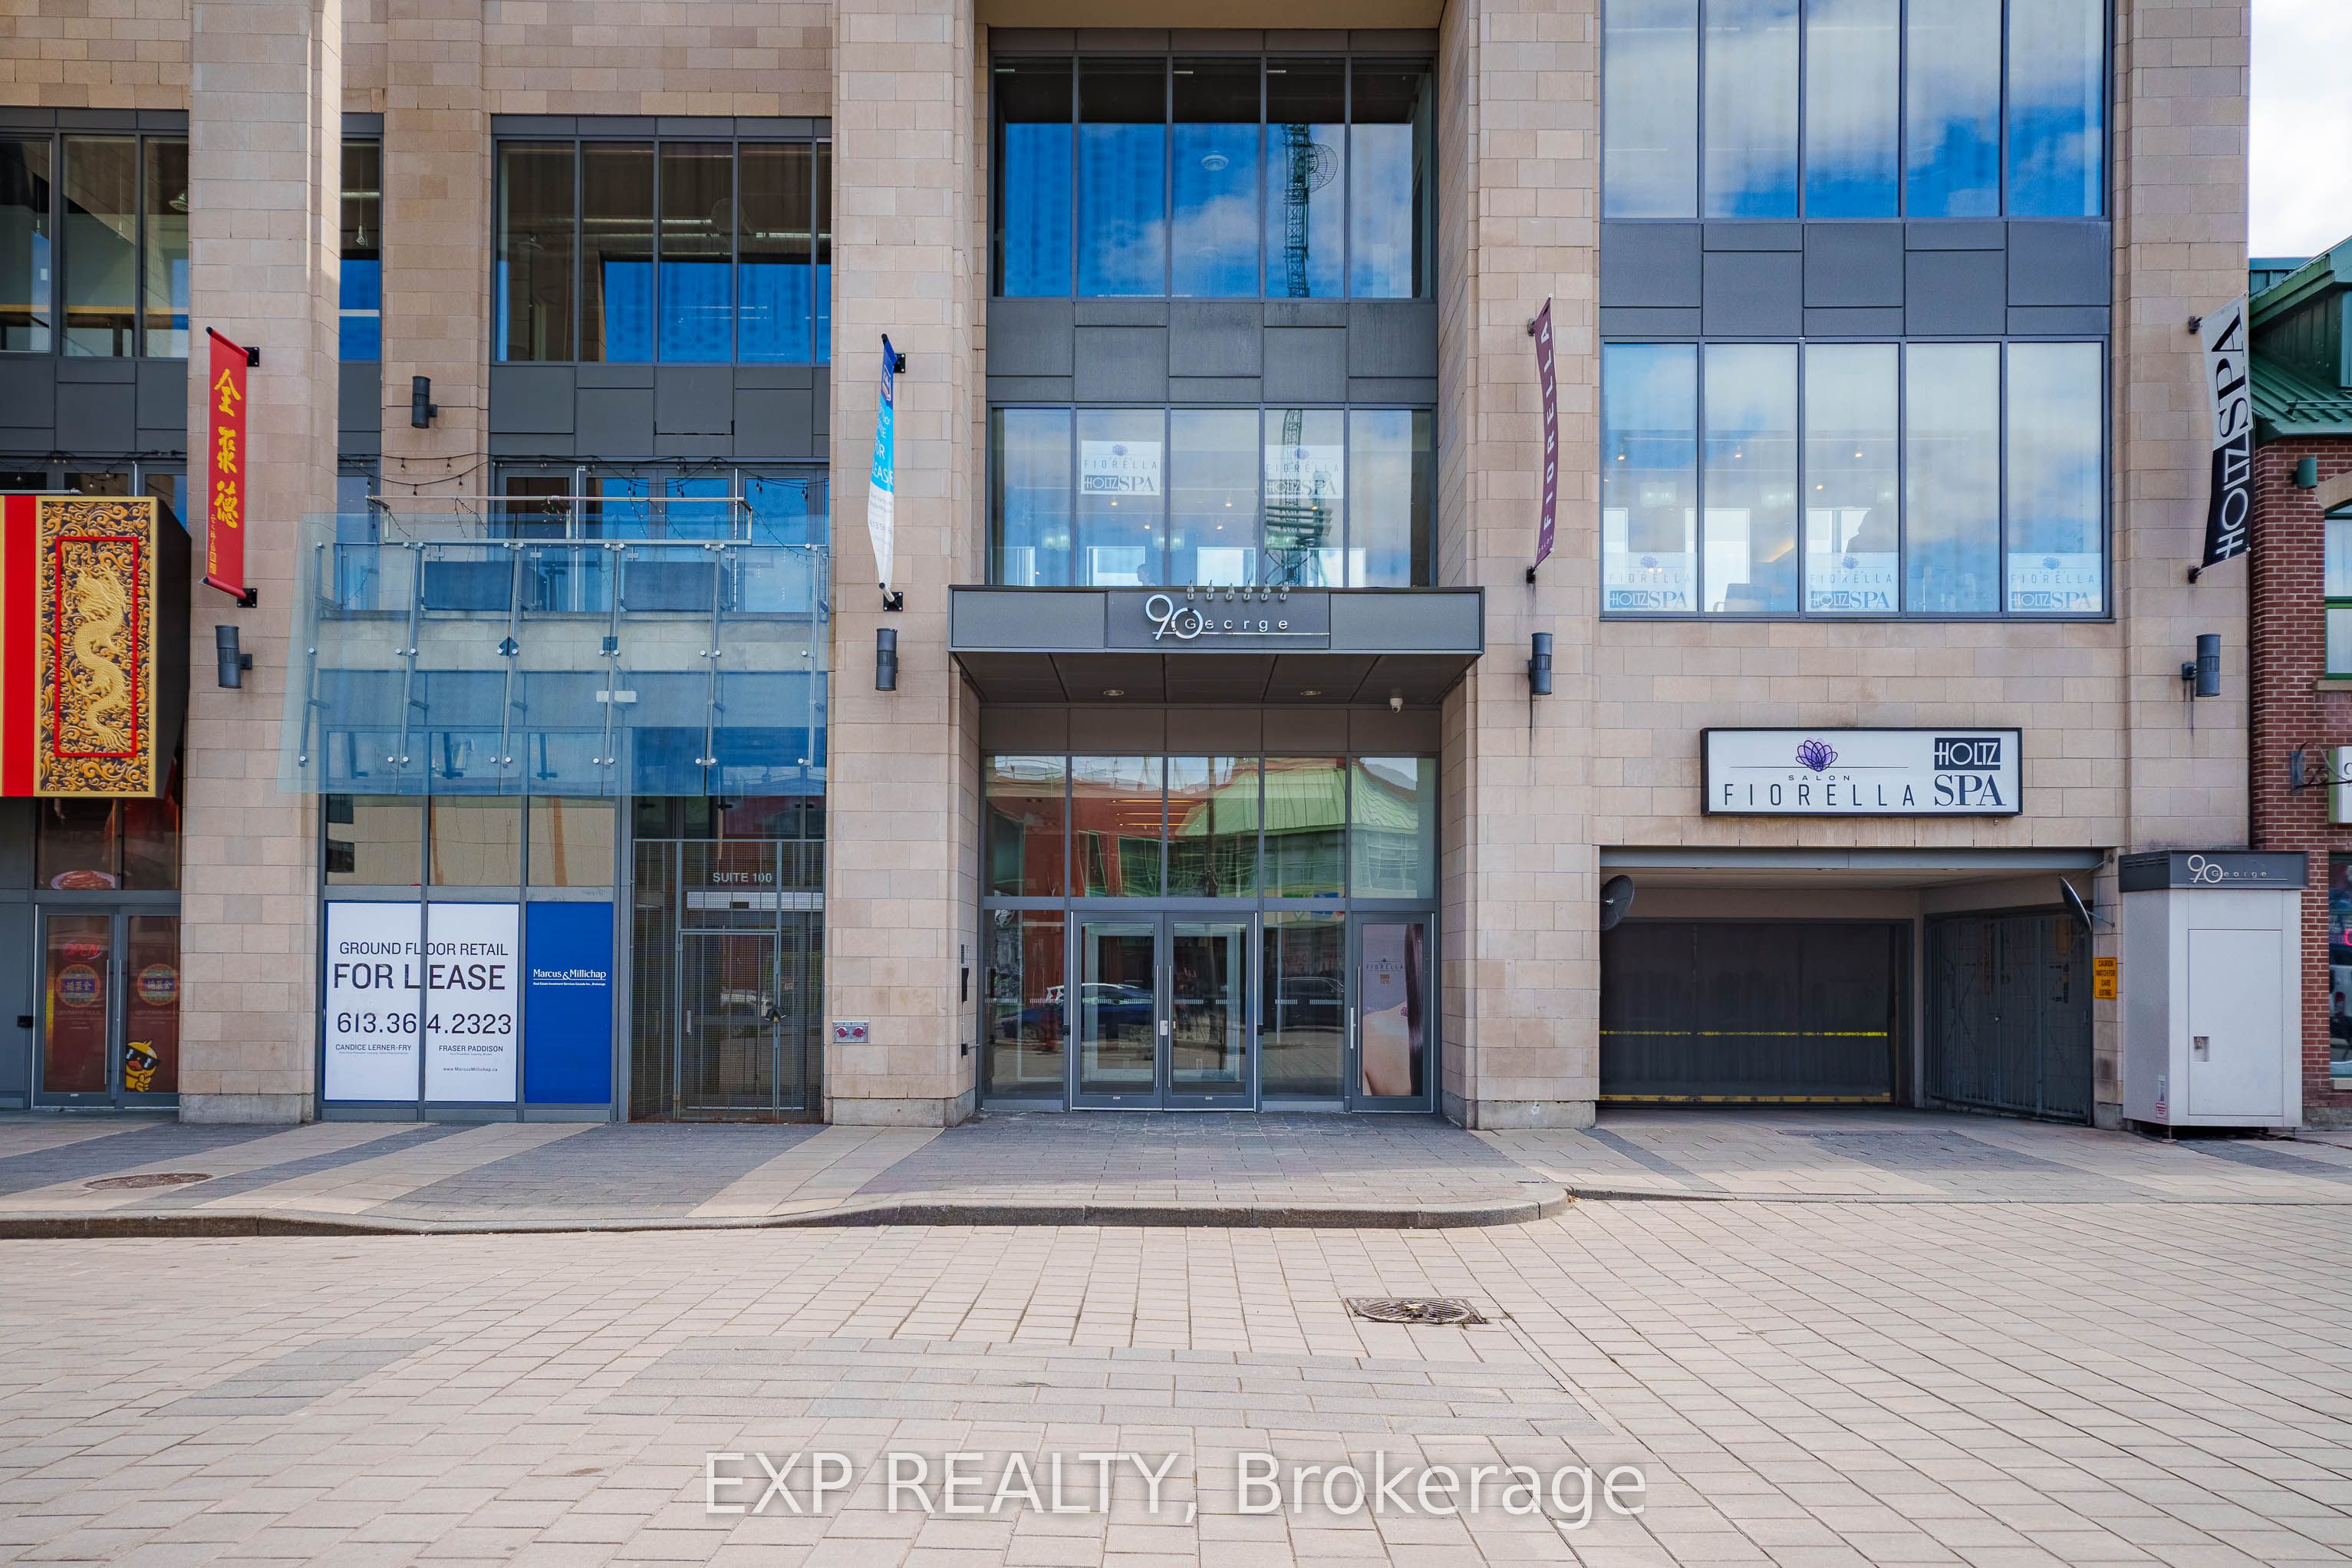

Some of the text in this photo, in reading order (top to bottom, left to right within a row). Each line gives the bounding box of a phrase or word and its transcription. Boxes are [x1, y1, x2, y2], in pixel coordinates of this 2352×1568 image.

[1540, 321, 1554, 532] FIORELLA
[2211, 306, 2251, 559] HOLTZ SPA
[213, 367, 242, 529] 全聚德
[1084, 460, 1157, 469] FIORELLA
[1266, 464, 1339, 473] FIORELLA
[1085, 476, 1155, 492] HOLTZ SPA
[1302, 479, 1336, 495] SPA
[1810, 574, 1892, 584] FIORELLA
[2011, 574, 2094, 584] FIORELLA
[1609, 590, 1688, 608] HOLTZ SPA
[1810, 591, 1891, 608] HOLTZ SPA
[2051, 591, 2093, 609] SPA
[1145, 595, 1289, 641] 90 George
[1934, 742, 2001, 766] HOLTZ
[1724, 784, 1915, 806] FIORELLA
[1934, 773, 2007, 807] SPA
[713, 872, 772, 883] SUITE 100
[2188, 855, 2267, 884] 90 George
[61, 943, 100, 957] OPEN
[339, 941, 509, 956] GROUND FLOOR RETAIL
[334, 963, 506, 990] FOR LEASE
[533, 968, 562, 978] Marcus
[569, 969, 607, 980] Millichap
[337, 1012, 512, 1035] 613.364.2323
